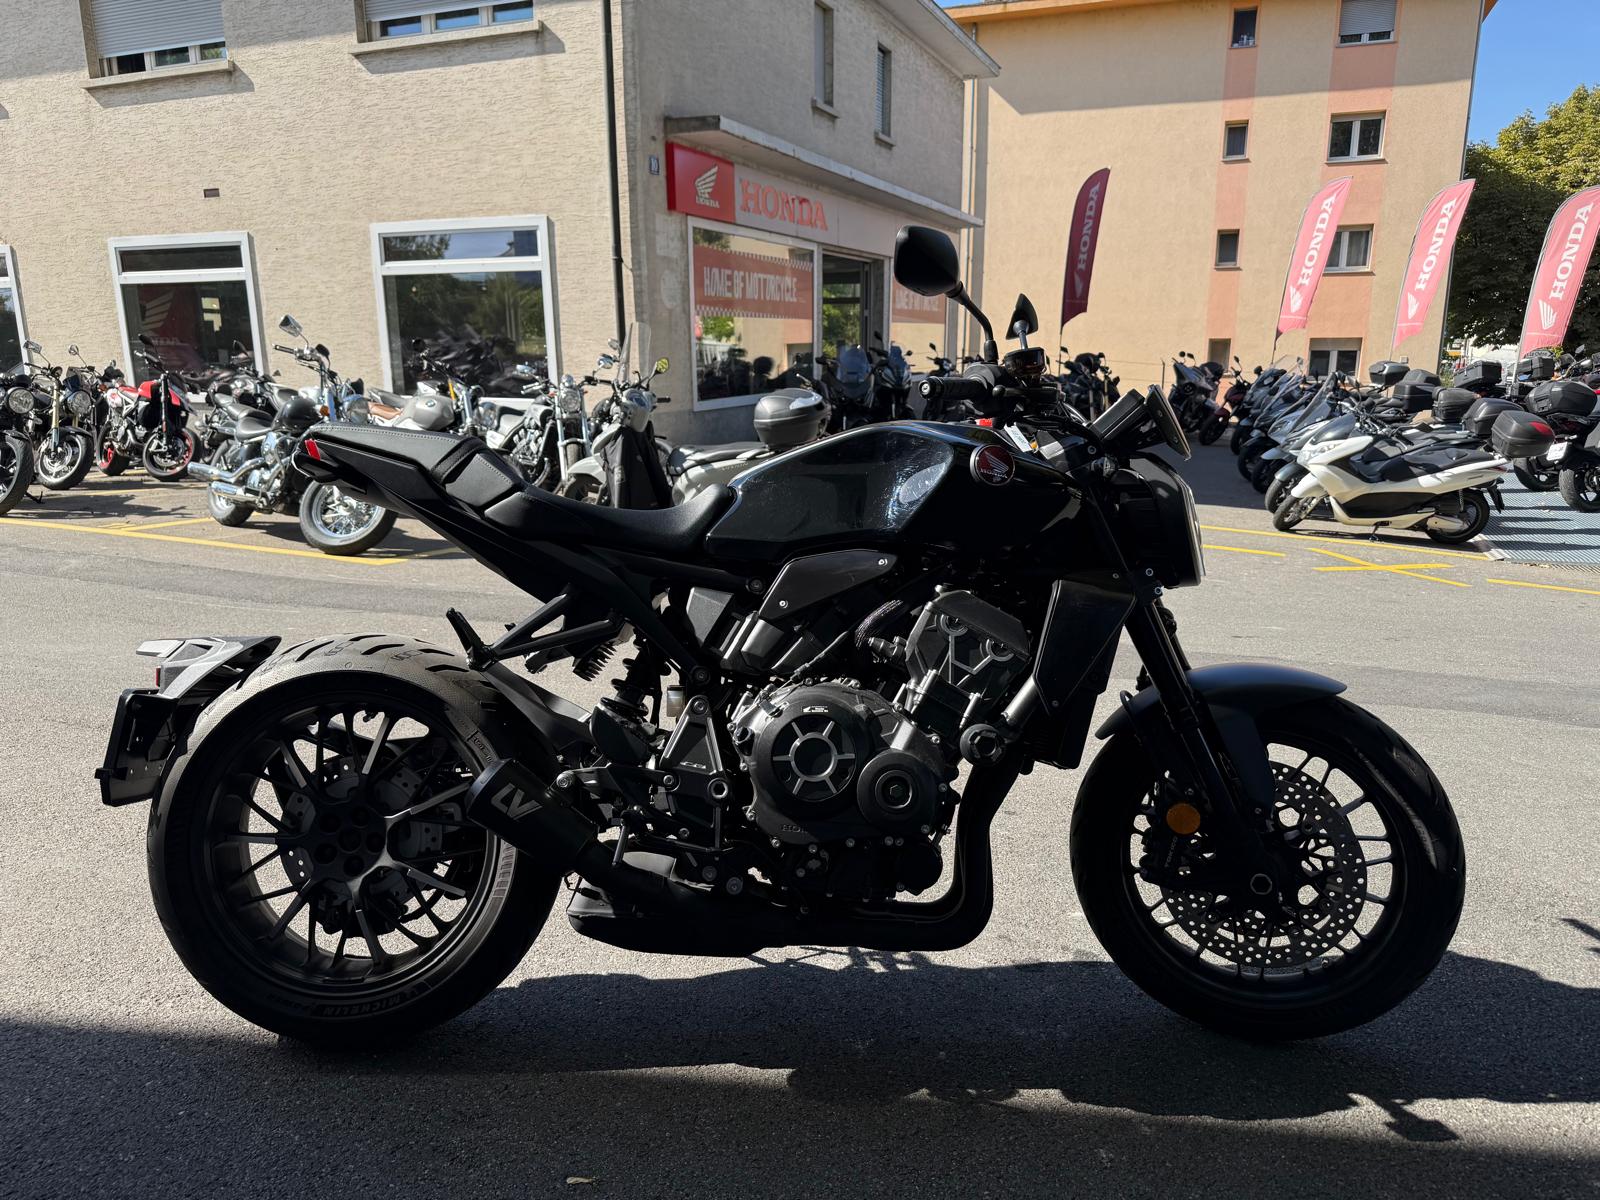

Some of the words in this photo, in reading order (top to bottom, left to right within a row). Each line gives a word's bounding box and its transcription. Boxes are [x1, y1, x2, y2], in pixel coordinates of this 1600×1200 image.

[740, 178, 828, 231] HONDA
[1077, 182, 1100, 271] HONDA
[1298, 193, 1336, 286] HONDA
[1415, 199, 1457, 291] HONDA
[703, 266, 732, 297] HOME
[733, 270, 744, 299] OF
[1549, 202, 1594, 300] HONDA
